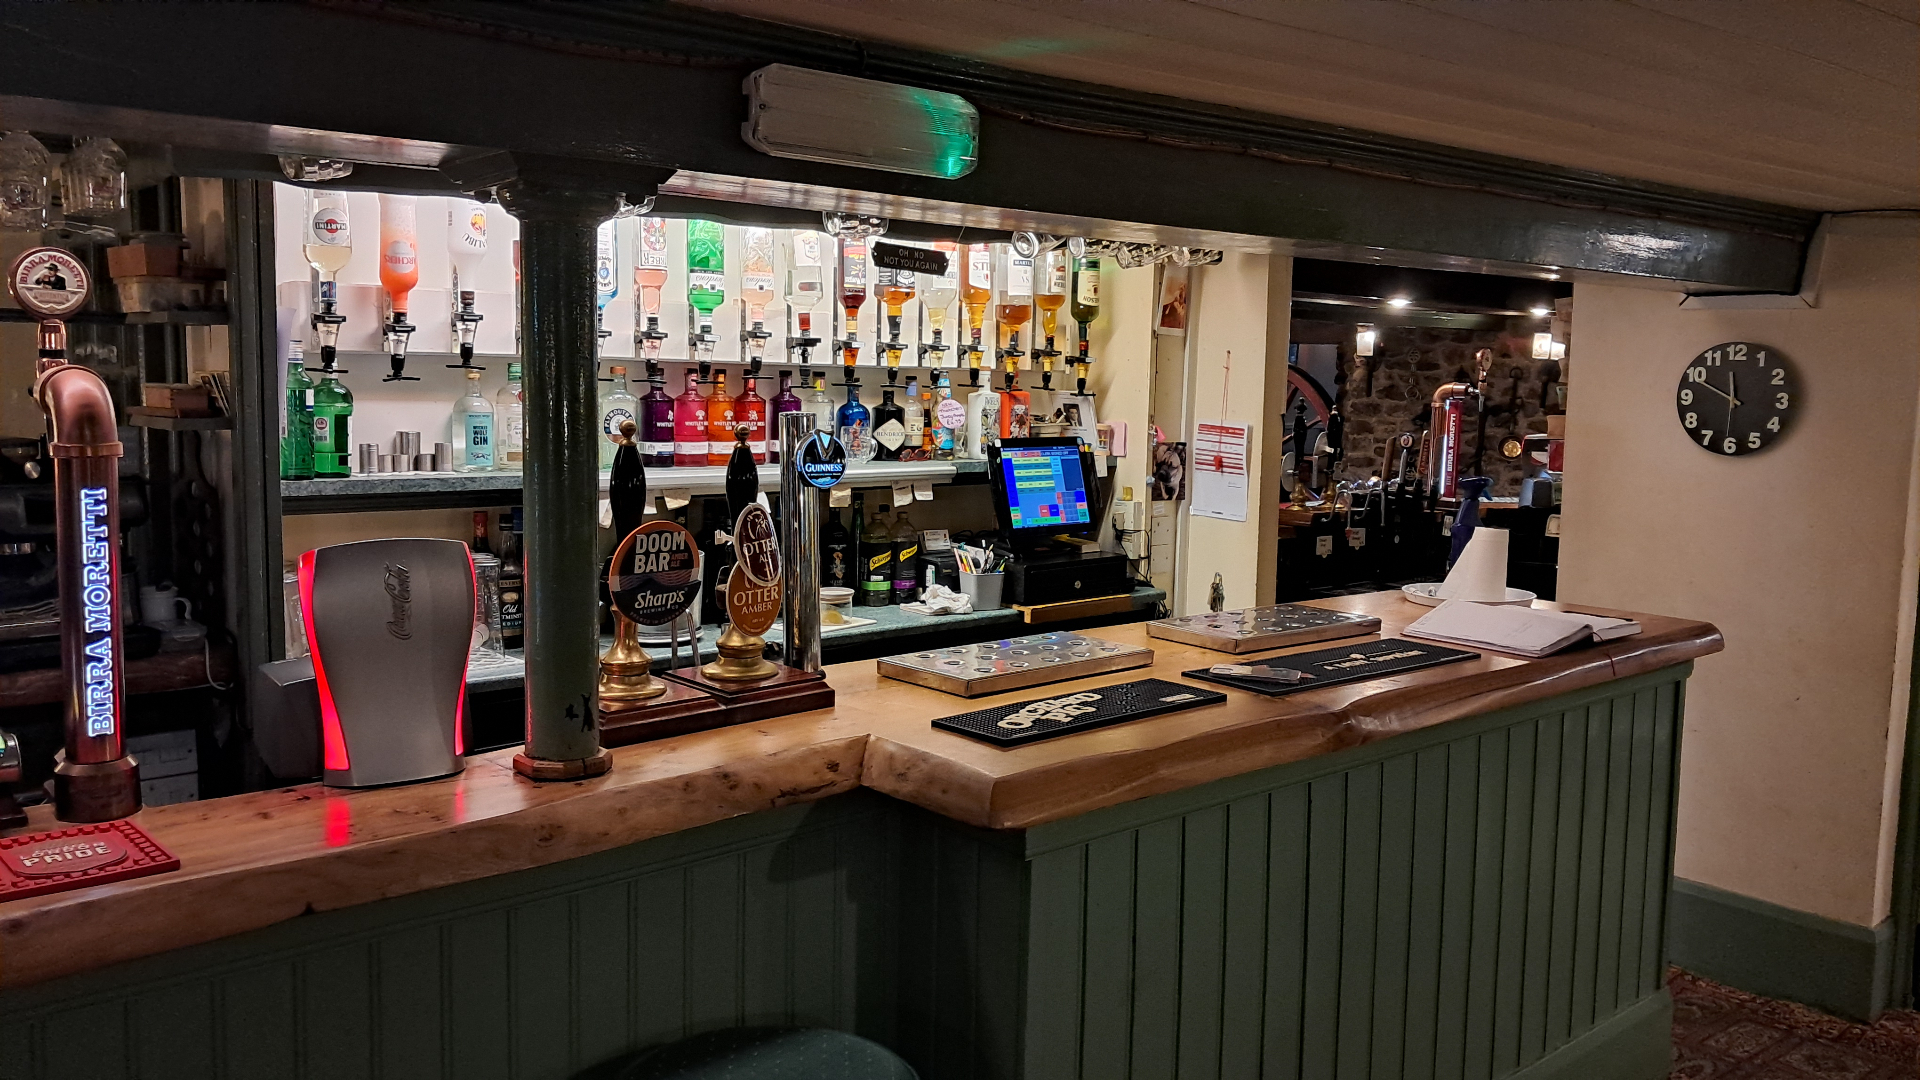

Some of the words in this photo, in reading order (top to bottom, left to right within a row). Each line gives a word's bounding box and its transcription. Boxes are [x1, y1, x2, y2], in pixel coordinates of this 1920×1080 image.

[316, 222, 346, 230] MARTINI
[462, 233, 487, 248] ALIBU
[899, 249, 908, 257] OH
[914, 251, 924, 259] NO
[884, 256, 898, 265] NOT
[900, 258, 914, 267] YOU
[915, 262, 938, 270] AGAIN
[20, 256, 47, 284] BIRRA
[47, 255, 85, 288] MORETTI
[1705, 350, 1721, 366] 11
[1727, 344, 1747, 360] 12
[1757, 351, 1766, 367] 1
[1687, 367, 1706, 383] 10
[1771, 369, 1785, 385] 2
[1680, 389, 1693, 405] 9
[1775, 392, 1789, 409] 3
[604, 409, 630, 427] PLYMOUTH
[1685, 412, 1698, 428] 8
[1767, 416, 1780, 432] 4
[473, 436, 488, 445] GIN
[1701, 430, 1713, 445] 7
[1723, 437, 1736, 454] 6
[1748, 432, 1761, 449] 5
[805, 463, 843, 472] GUINNESS
[636, 531, 686, 553] DOOM
[743, 537, 777, 556] OTTER
[81, 487, 113, 633] MORETTI
[634, 552, 670, 574] BAR
[384, 561, 413, 640] Coca-Cola
[634, 590, 686, 609] Sharp's
[733, 586, 779, 606] OTTER
[503, 604, 518, 613] Old
[741, 602, 773, 614] AMBER
[86, 638, 114, 738] BIRRA
[1040, 705, 1097, 723] PIG
[22, 846, 111, 867] PRIDE
